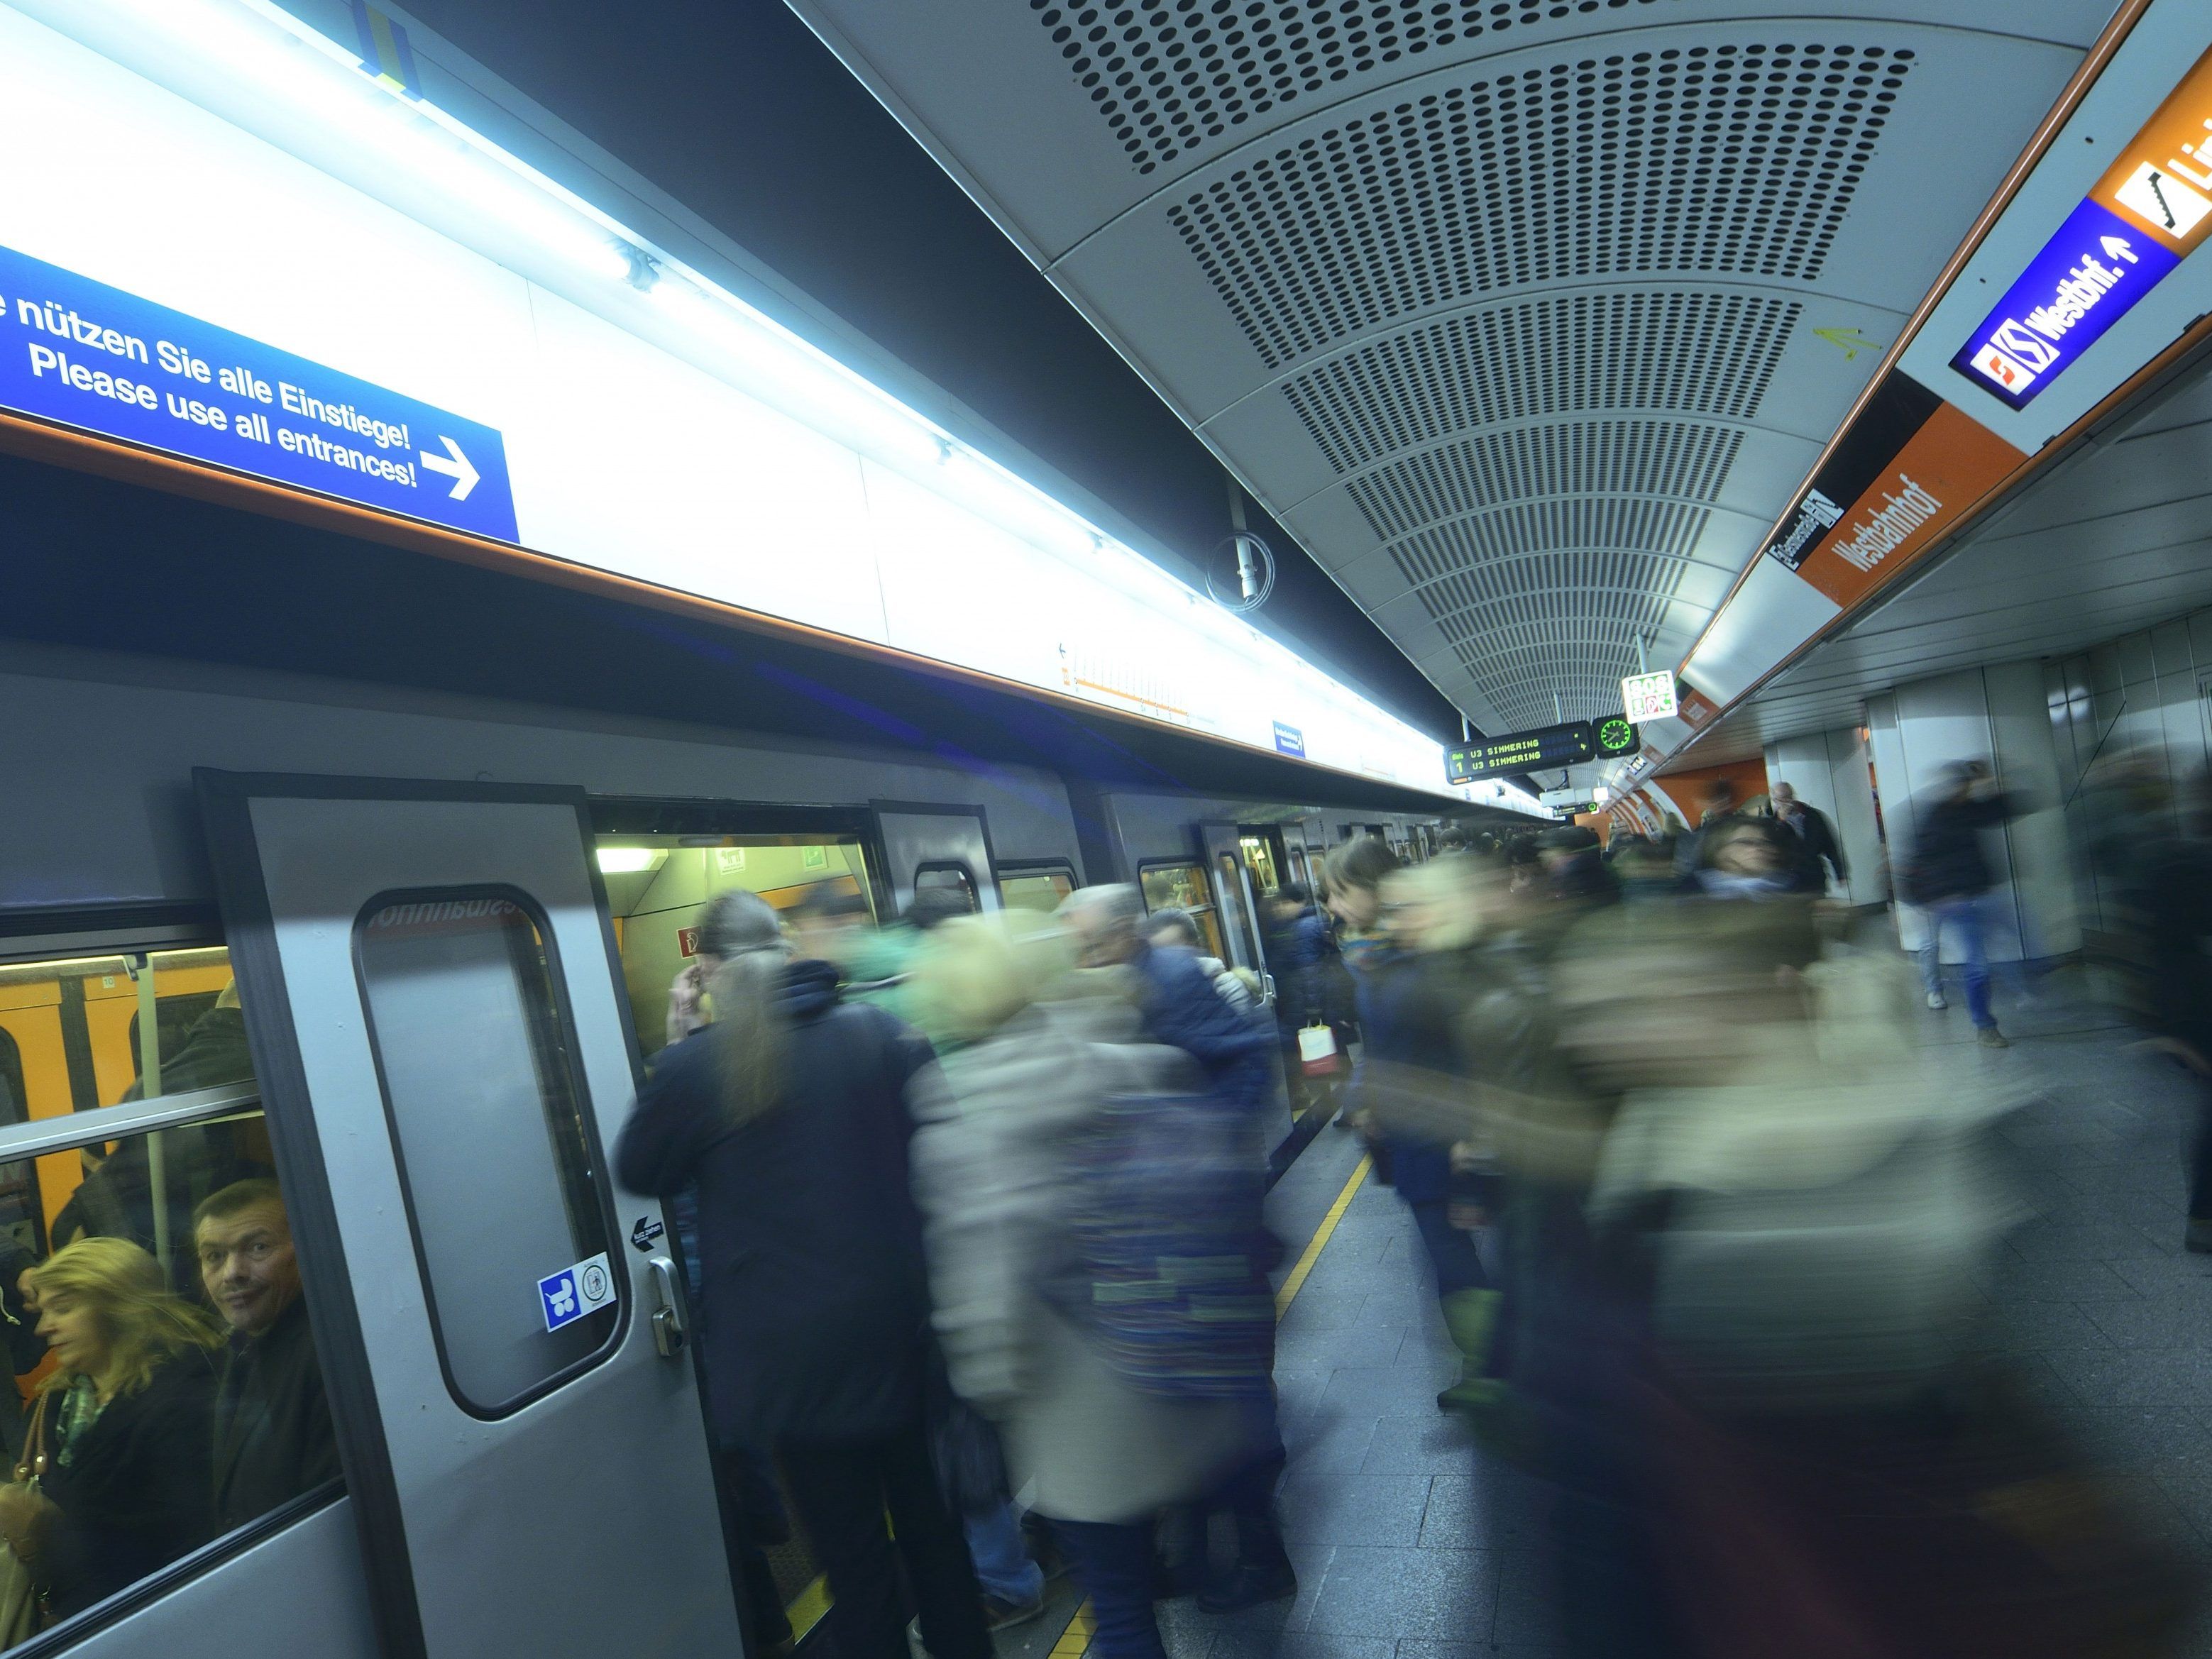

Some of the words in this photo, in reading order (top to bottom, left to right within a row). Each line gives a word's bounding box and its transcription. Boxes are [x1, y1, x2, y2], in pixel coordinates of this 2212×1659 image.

[2024, 253, 2124, 341] Westbhf.
[17, 298, 148, 364] nützen
[157, 341, 211, 383] Sie
[219, 367, 273, 404] alle
[279, 382, 410, 450] Einstiege!
[29, 343, 158, 409] Please
[167, 393, 227, 430] use
[236, 415, 271, 444] all
[277, 429, 417, 487] entrances!
[1832, 473, 1942, 572] Westbahnhof
[1629, 675, 1668, 696] SOS
[1456, 762, 1463, 773] 1
[1470, 749, 1482, 759] U3
[1487, 739, 1539, 756] SIMMERING
[1473, 761, 1484, 770] U3
[1489, 751, 1541, 768] SIMMERING
